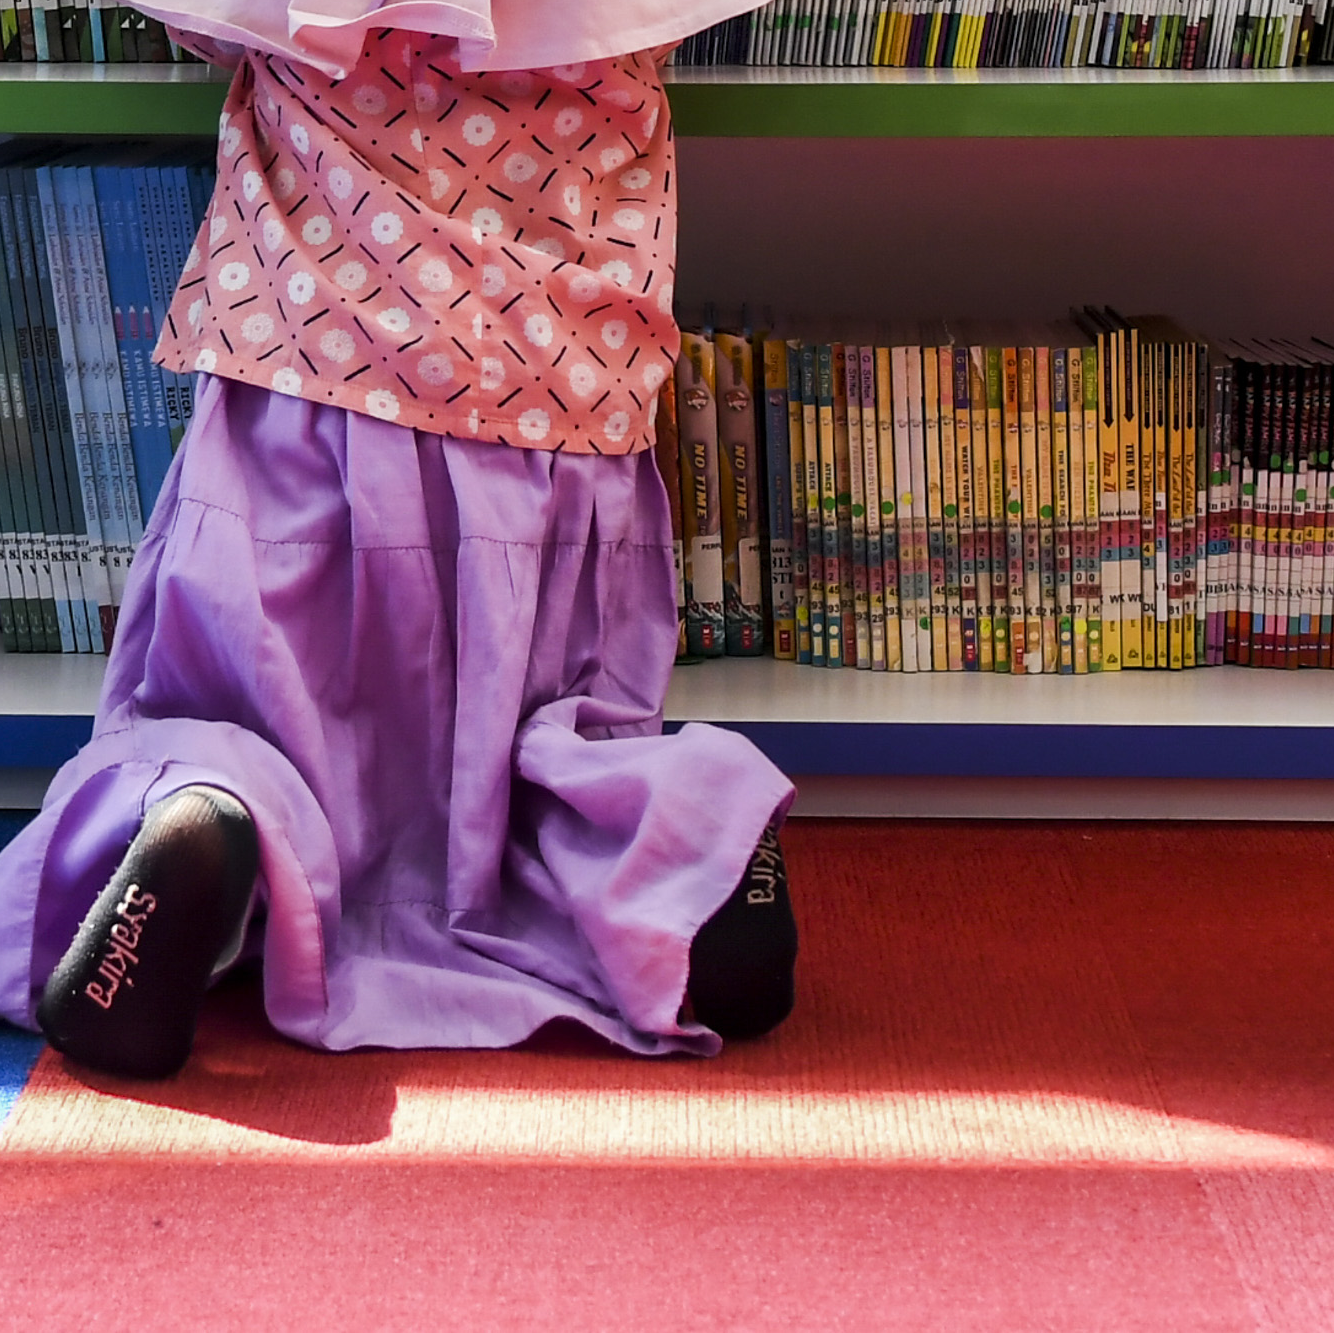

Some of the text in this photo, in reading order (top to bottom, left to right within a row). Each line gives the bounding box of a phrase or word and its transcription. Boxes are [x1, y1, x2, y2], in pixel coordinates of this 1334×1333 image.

[19, 327, 28, 359] Bruno
[166, 386, 180, 420] RICKY
[694, 444, 708, 520] NO TIME
[83, 883, 157, 1010] Syakira
